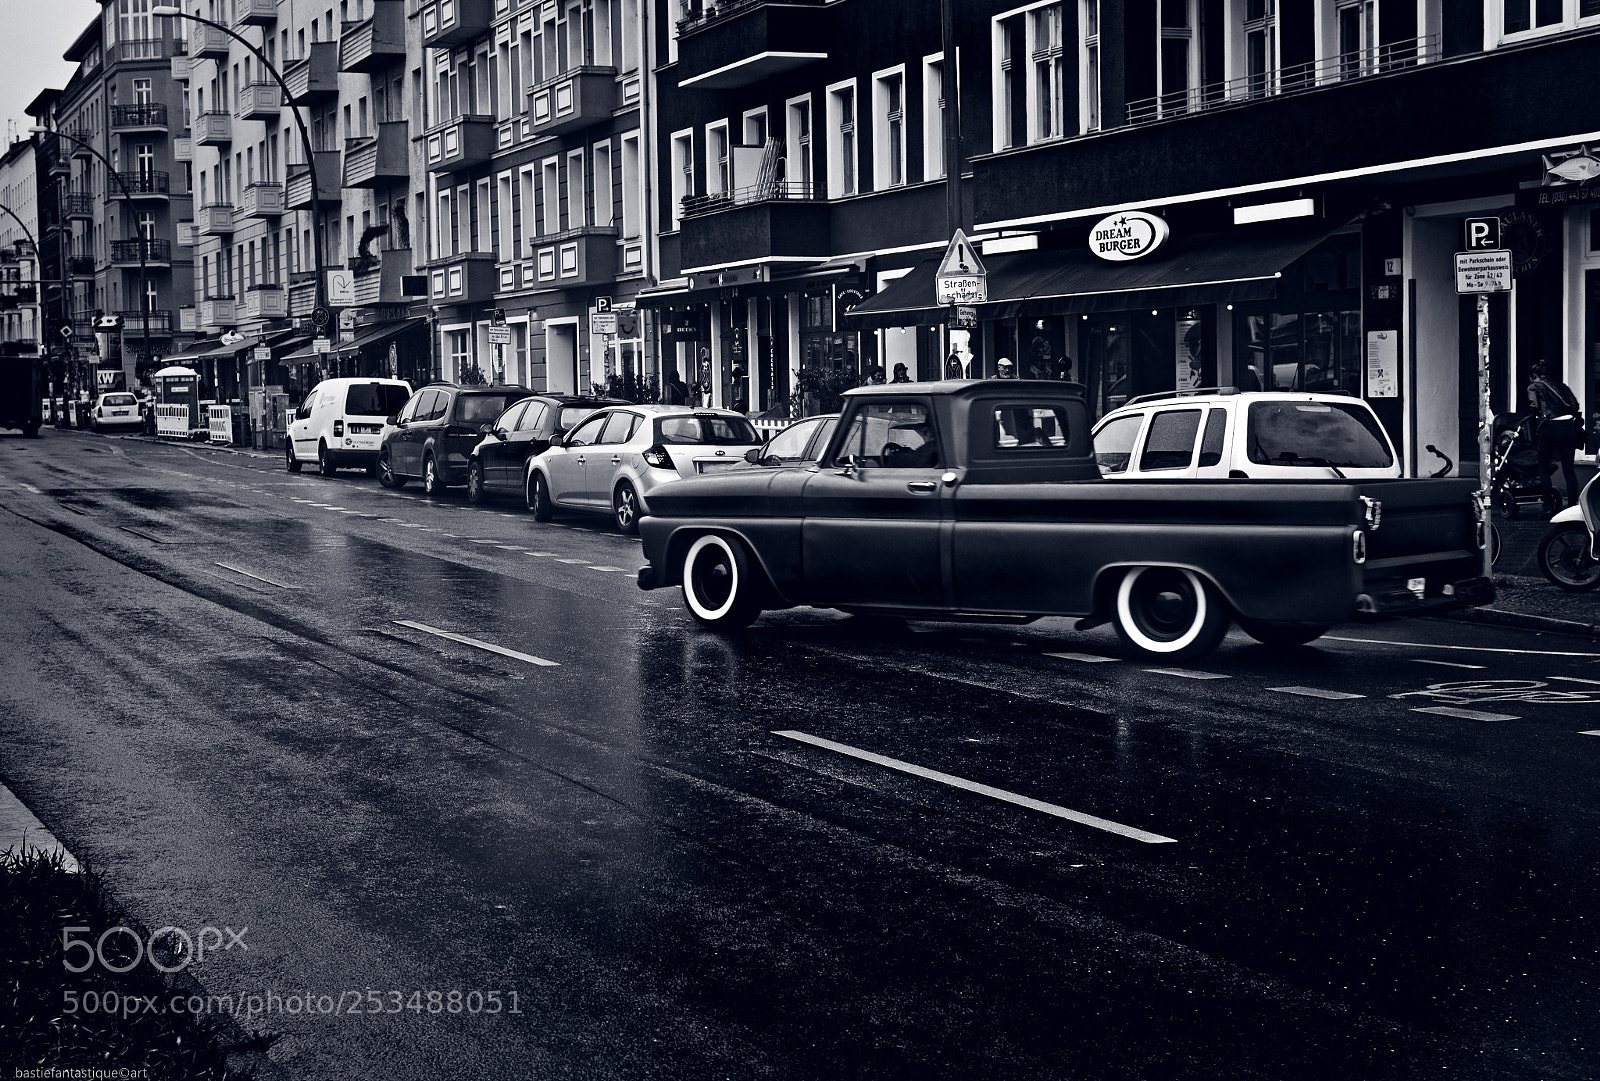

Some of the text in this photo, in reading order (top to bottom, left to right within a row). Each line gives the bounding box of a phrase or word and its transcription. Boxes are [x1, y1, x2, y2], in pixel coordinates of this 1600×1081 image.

[1500, 210, 1543, 238] AULANER
[1095, 227, 1132, 241] DREAM
[1471, 222, 1489, 247] P
[1098, 238, 1141, 253] BURGER
[1469, 256, 1495, 264] Parkschein
[1387, 261, 1394, 273] 12
[944, 279, 981, 289] Straßen-
[598, 299, 607, 310] P
